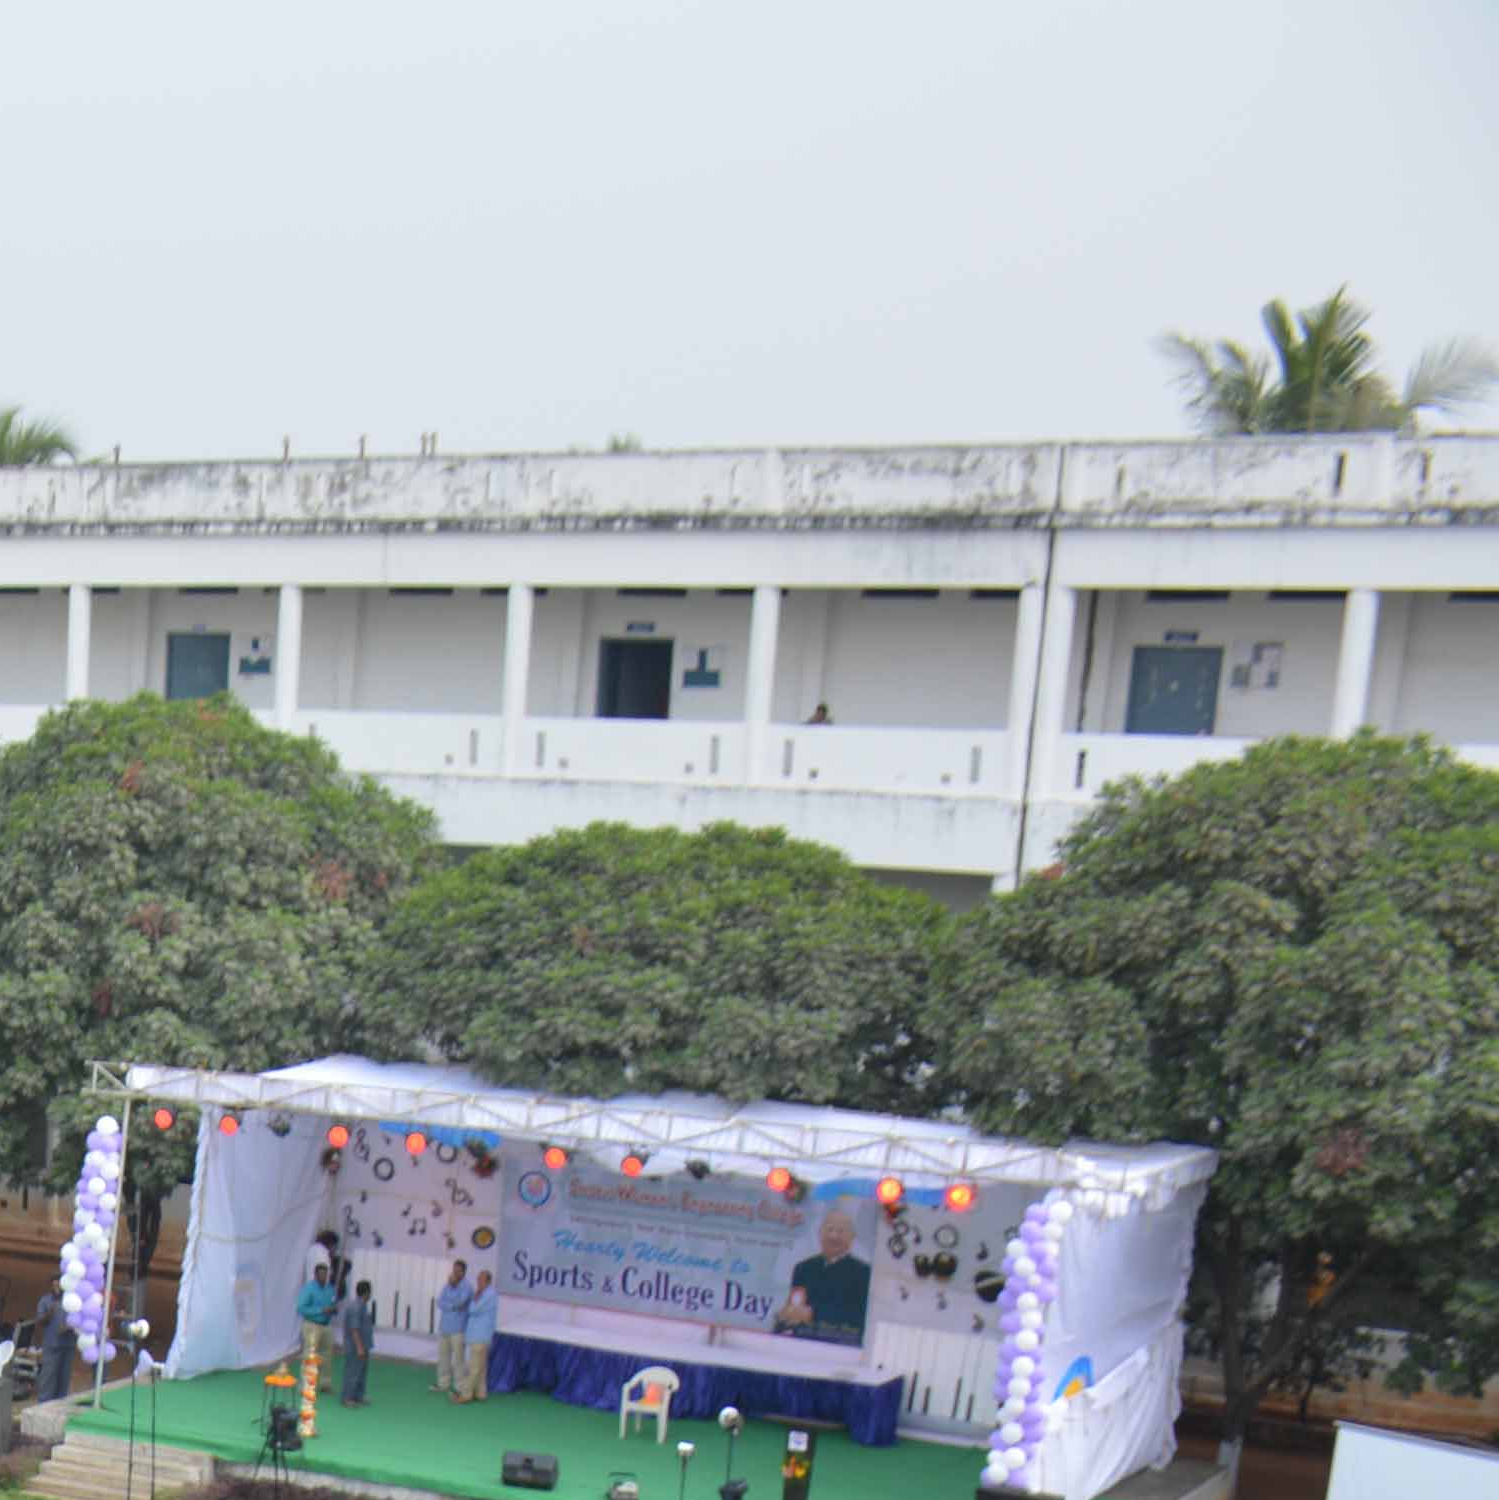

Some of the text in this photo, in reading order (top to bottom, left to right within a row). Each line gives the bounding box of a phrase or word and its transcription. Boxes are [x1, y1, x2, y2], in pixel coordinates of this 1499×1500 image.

[632, 1241, 723, 1271] Welcome
[512, 1250, 773, 1320] Sports & College Day
